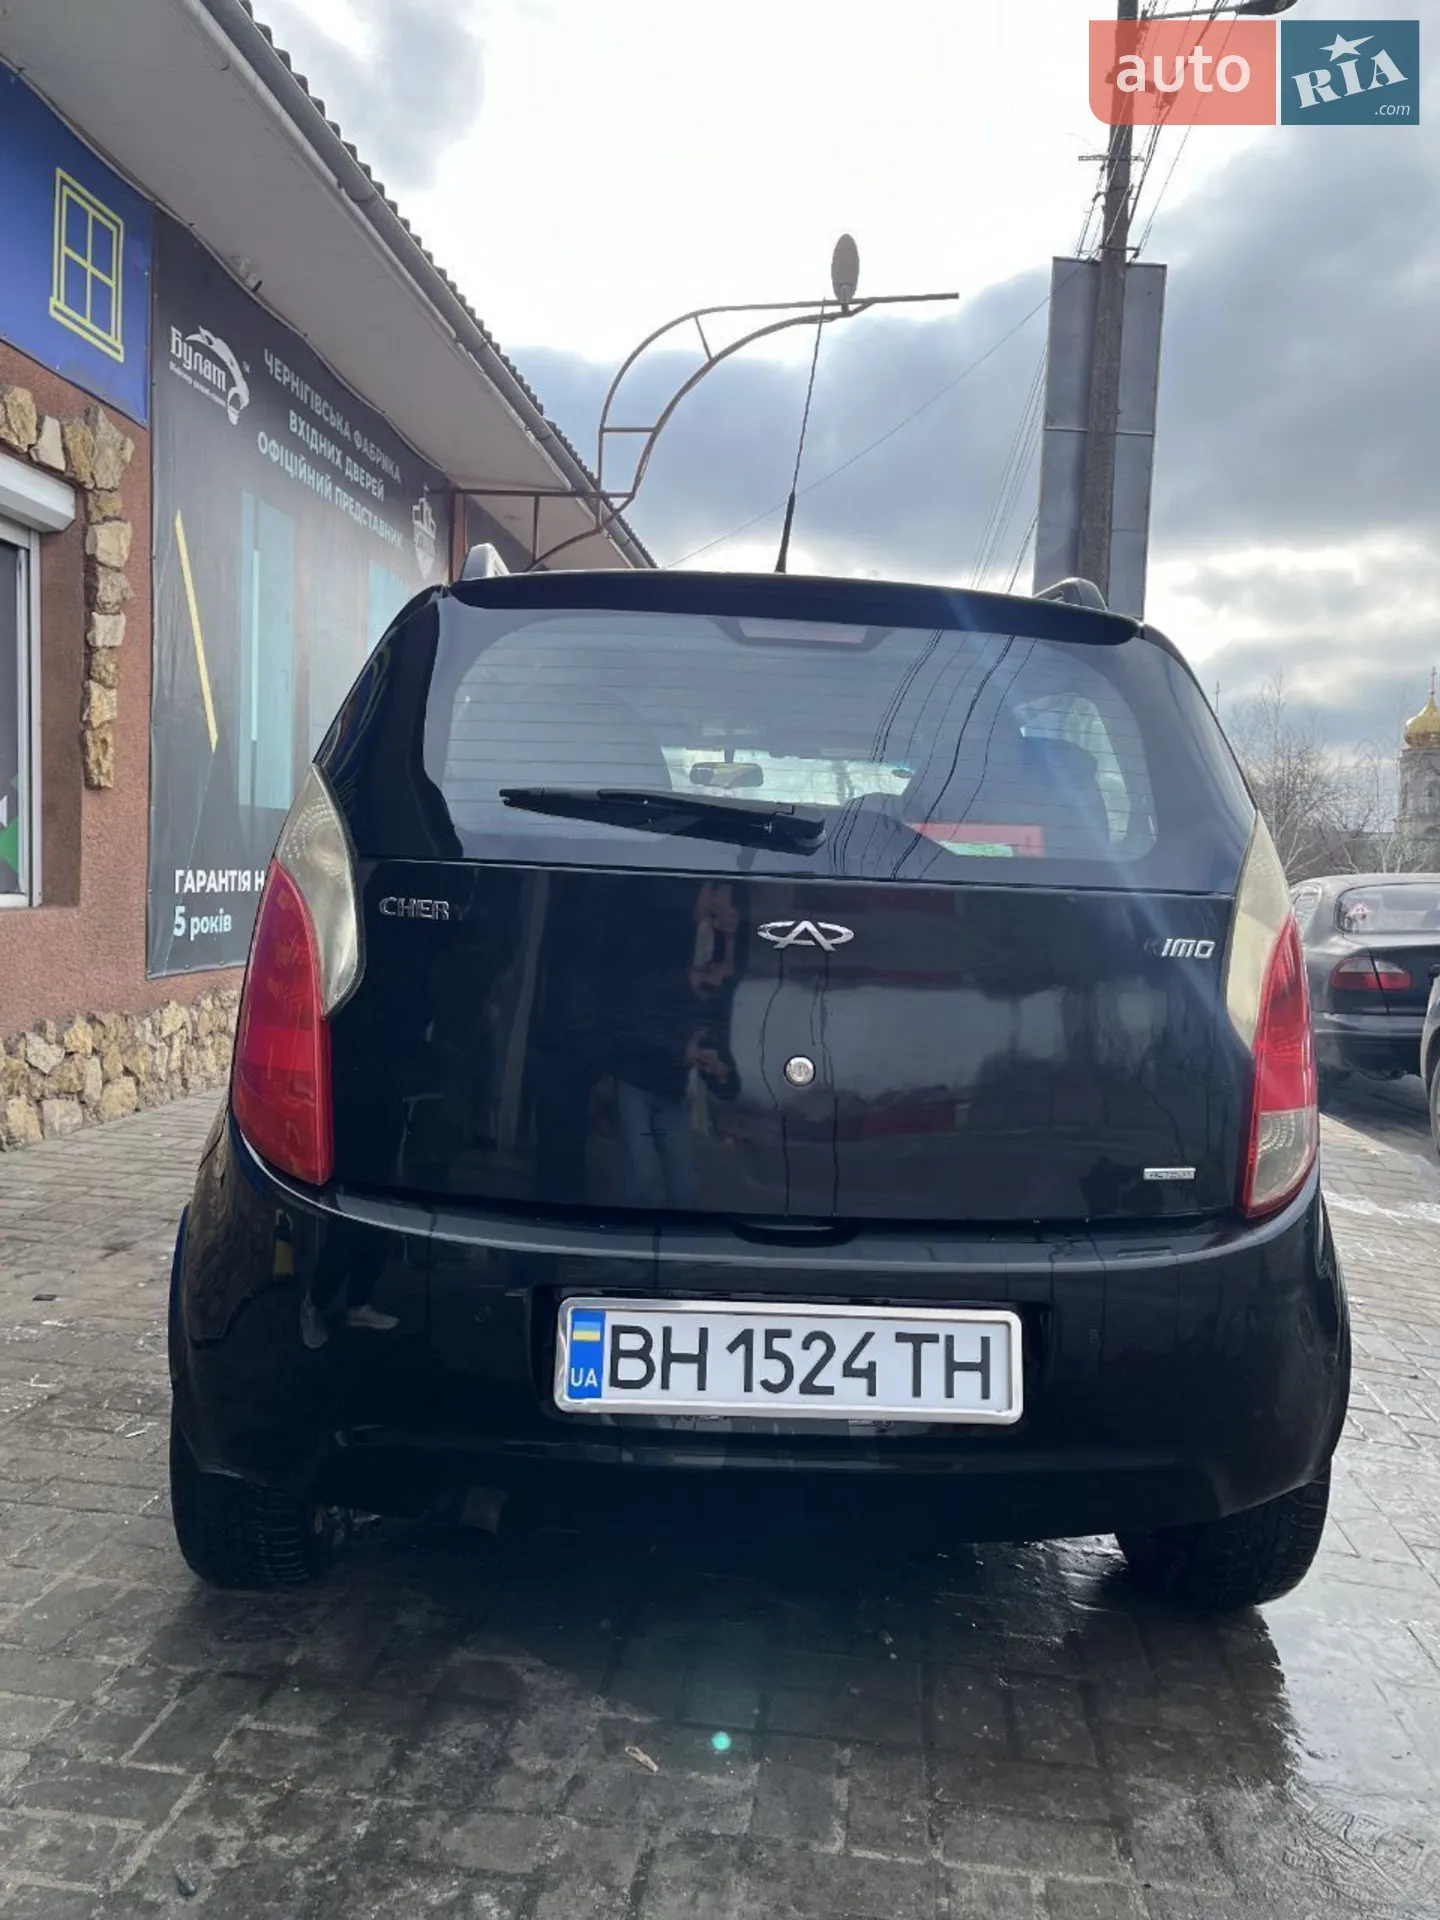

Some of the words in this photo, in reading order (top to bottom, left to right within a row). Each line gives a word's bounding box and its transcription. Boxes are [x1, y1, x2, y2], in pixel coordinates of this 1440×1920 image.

[170, 326, 227, 392] Булат
[264, 348, 351, 440] ЧЕРНІГІВСЬКА
[353, 430, 402, 485] ФАБРИКА
[257, 431, 332, 502] ОФІЦІЙНИЙ
[335, 486, 404, 551] ПРЕДСТАВНИК
[288, 410, 343, 469] ВХІДНИХ
[345, 457, 385, 502] ДВЕРЕЙ
[174, 869, 251, 894] ГАРАНТІЯ
[173, 905, 187, 937] 5
[189, 908, 232, 942] років
[570, 1366, 599, 1389] UA
[609, 1324, 708, 1391] BH
[726, 1328, 877, 1397] 1524
[895, 1331, 991, 1400] TH
